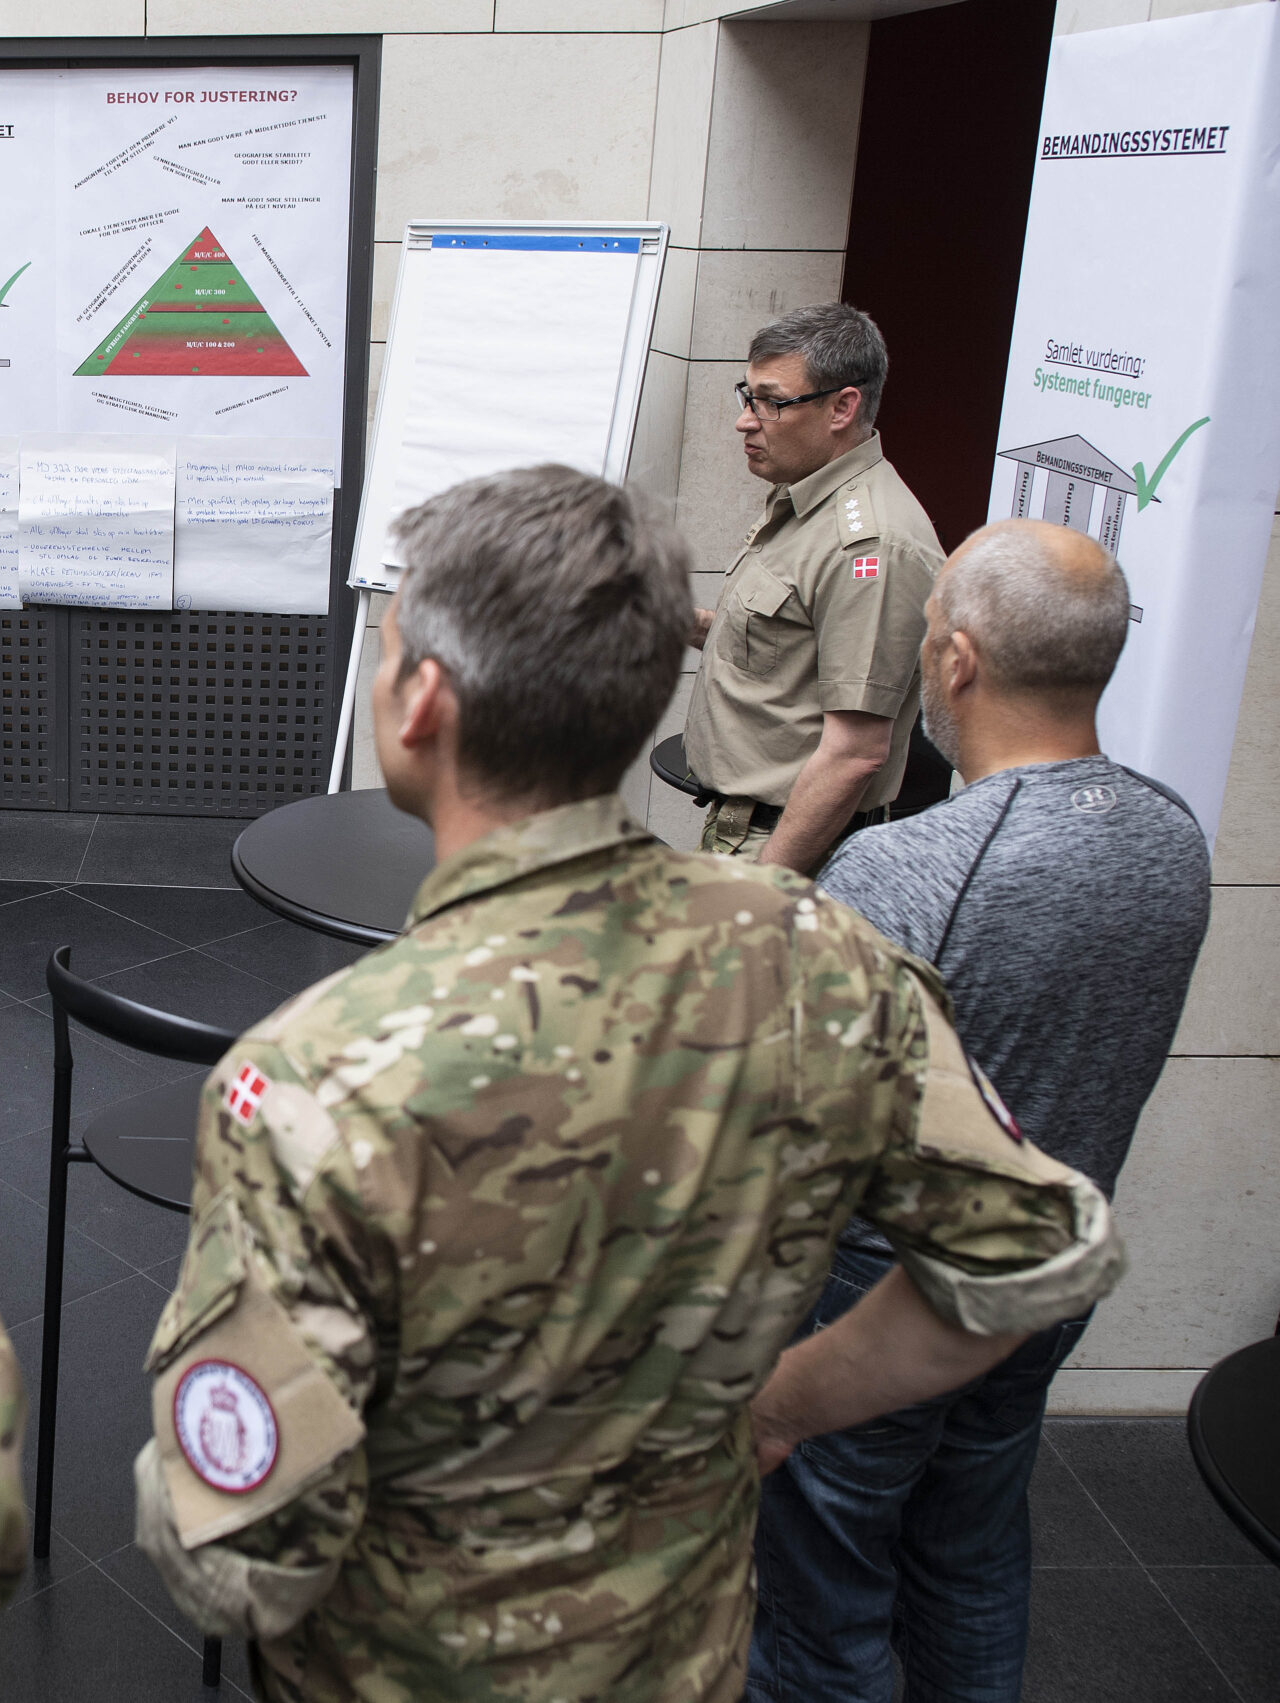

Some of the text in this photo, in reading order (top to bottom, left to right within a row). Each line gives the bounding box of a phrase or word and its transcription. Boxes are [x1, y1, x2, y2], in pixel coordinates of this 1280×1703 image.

[106, 90, 298, 104] BEHOV FOR JUSTERING?
[106, 149, 129, 167] FORTSAT
[129, 141, 141, 151] DEN
[141, 124, 166, 142] PRIMÆRE
[167, 115, 178, 125] VEJ
[225, 132, 242, 140] VÆRE
[255, 120, 297, 134] MIDLERTIDIG
[297, 114, 327, 125] TJENESTE
[1041, 125, 1230, 160] BEMANDINGSSYSTEMET
[121, 157, 129, 165] NY
[130, 140, 155, 159] STILLING
[162, 165, 174, 173] DEN
[80, 227, 101, 236] LOKALE
[164, 208, 180, 216] GODE
[122, 225, 137, 233] UNGE
[145, 237, 152, 245] ER
[86, 313, 93, 321] DE
[93, 296, 107, 313] SAMME
[108, 286, 118, 296] SOM
[117, 275, 128, 286] FOR
[130, 264, 138, 272] ÅR
[137, 248, 152, 263] SIDEN
[316, 328, 332, 348] SYSTEM
[1045, 339, 1146, 378] Samlet vurdering:
[1033, 368, 1152, 410] Systemet fungerer
[1036, 451, 1113, 483] BEMANDINGSSYSTEMET
[1018, 472, 1029, 519] ordring
[1064, 482, 1075, 526] gning
[1103, 515, 1111, 546] okale
[1110, 495, 1122, 552] steplaner
